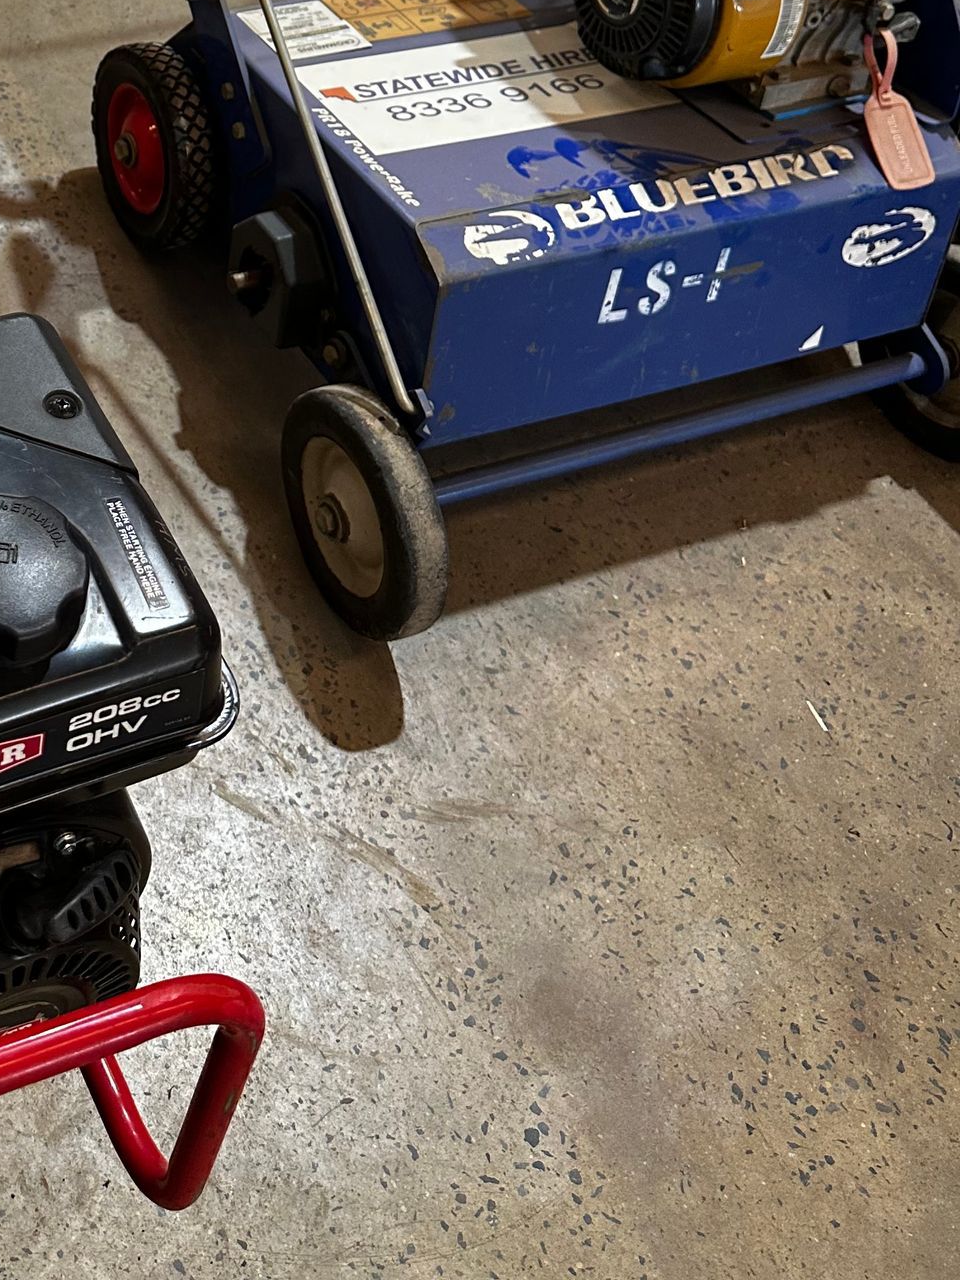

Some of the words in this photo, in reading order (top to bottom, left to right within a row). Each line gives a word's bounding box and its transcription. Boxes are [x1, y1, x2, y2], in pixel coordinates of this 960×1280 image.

[354, 59, 526, 98] STATEWIDE
[386, 93, 492, 121] 8336
[499, 73, 604, 102] 9166
[311, 108, 352, 137] PR18
[10, 502, 68, 548] ETHANOL
[114, 500, 130, 525] WHEN
[125, 523, 148, 566] STARTING
[107, 502, 123, 528] PLACE
[118, 527, 134, 551] FREE
[128, 550, 145, 575] HAND
[140, 574, 156, 599] HERE
[68, 688, 181, 732] 208cc
[66, 715, 147, 752] OHV
